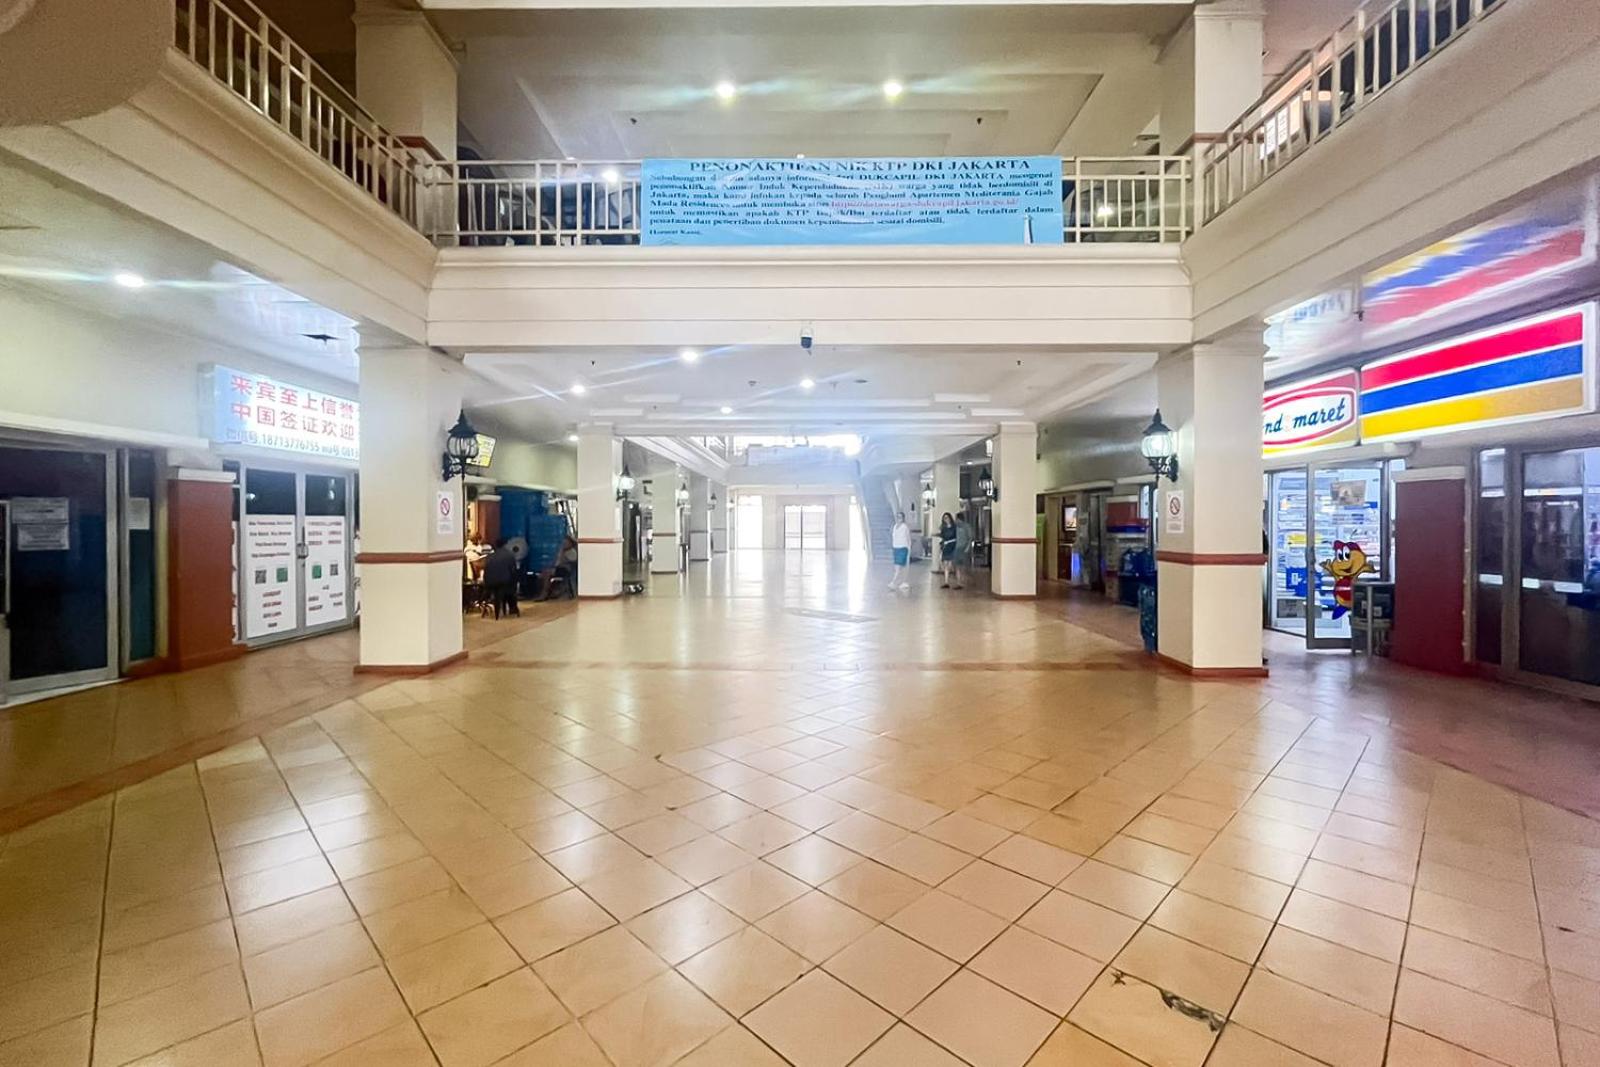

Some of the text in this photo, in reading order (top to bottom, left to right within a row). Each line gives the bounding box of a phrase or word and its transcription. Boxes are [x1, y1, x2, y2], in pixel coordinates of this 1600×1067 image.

[873, 161, 908, 172] KTP
[912, 161, 943, 171] DKI
[948, 160, 1030, 171] JAKARTA
[951, 172, 1004, 180] JAKARTA
[932, 183, 955, 191] yang
[787, 209, 810, 217] KTP
[1024, 205, 1055, 214] dalam
[694, 217, 712, 225] dan
[231, 401, 355, 441] 中国签证欢迎
